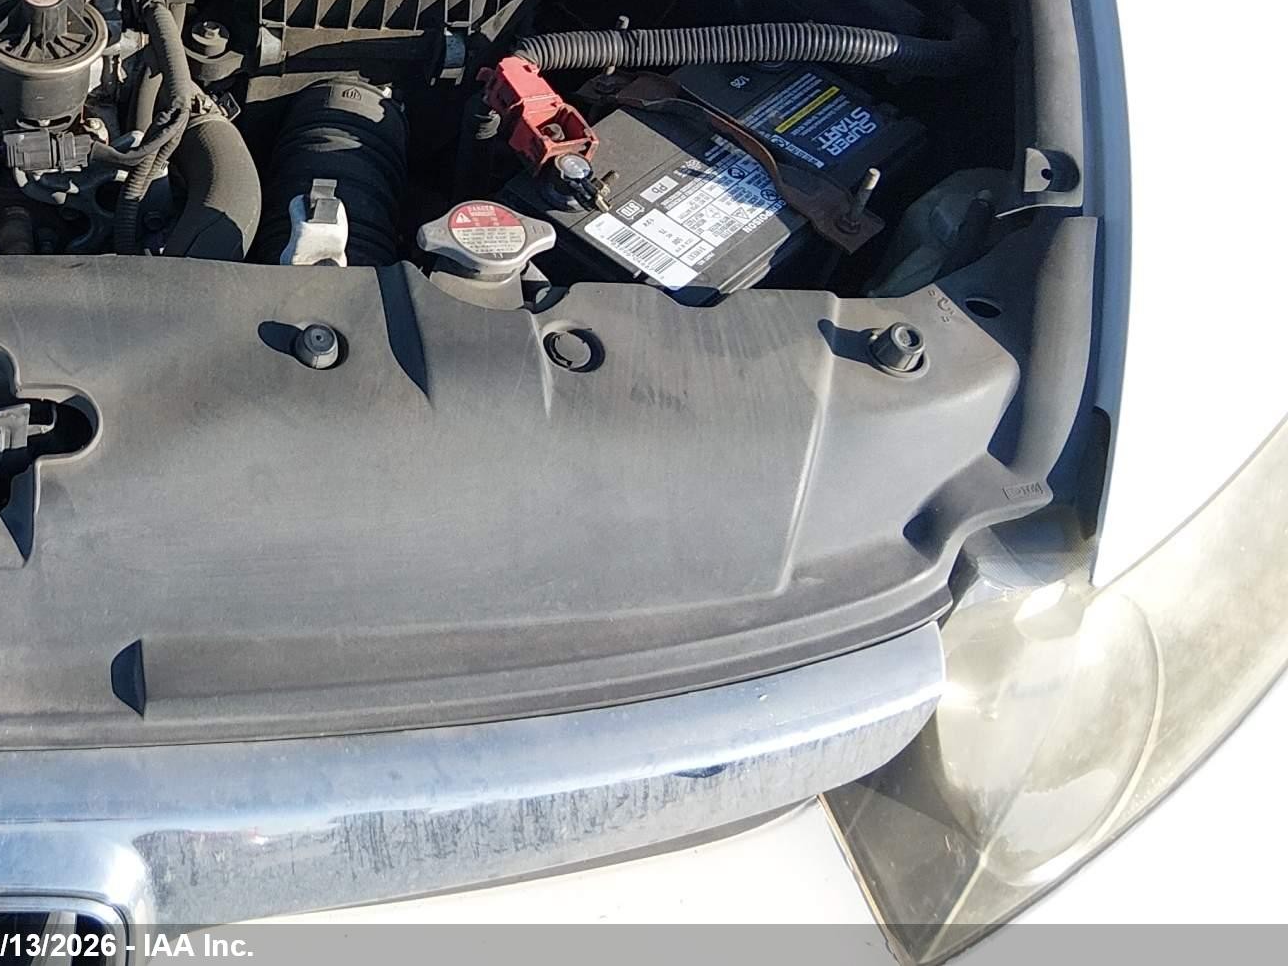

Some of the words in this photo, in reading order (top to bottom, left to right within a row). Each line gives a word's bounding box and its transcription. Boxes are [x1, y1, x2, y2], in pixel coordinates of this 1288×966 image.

[819, 106, 871, 150] START
[827, 121, 877, 157] SUPER
[653, 184, 668, 194] Pb
[621, 202, 641, 217] STD
[742, 209, 776, 234] POISON
